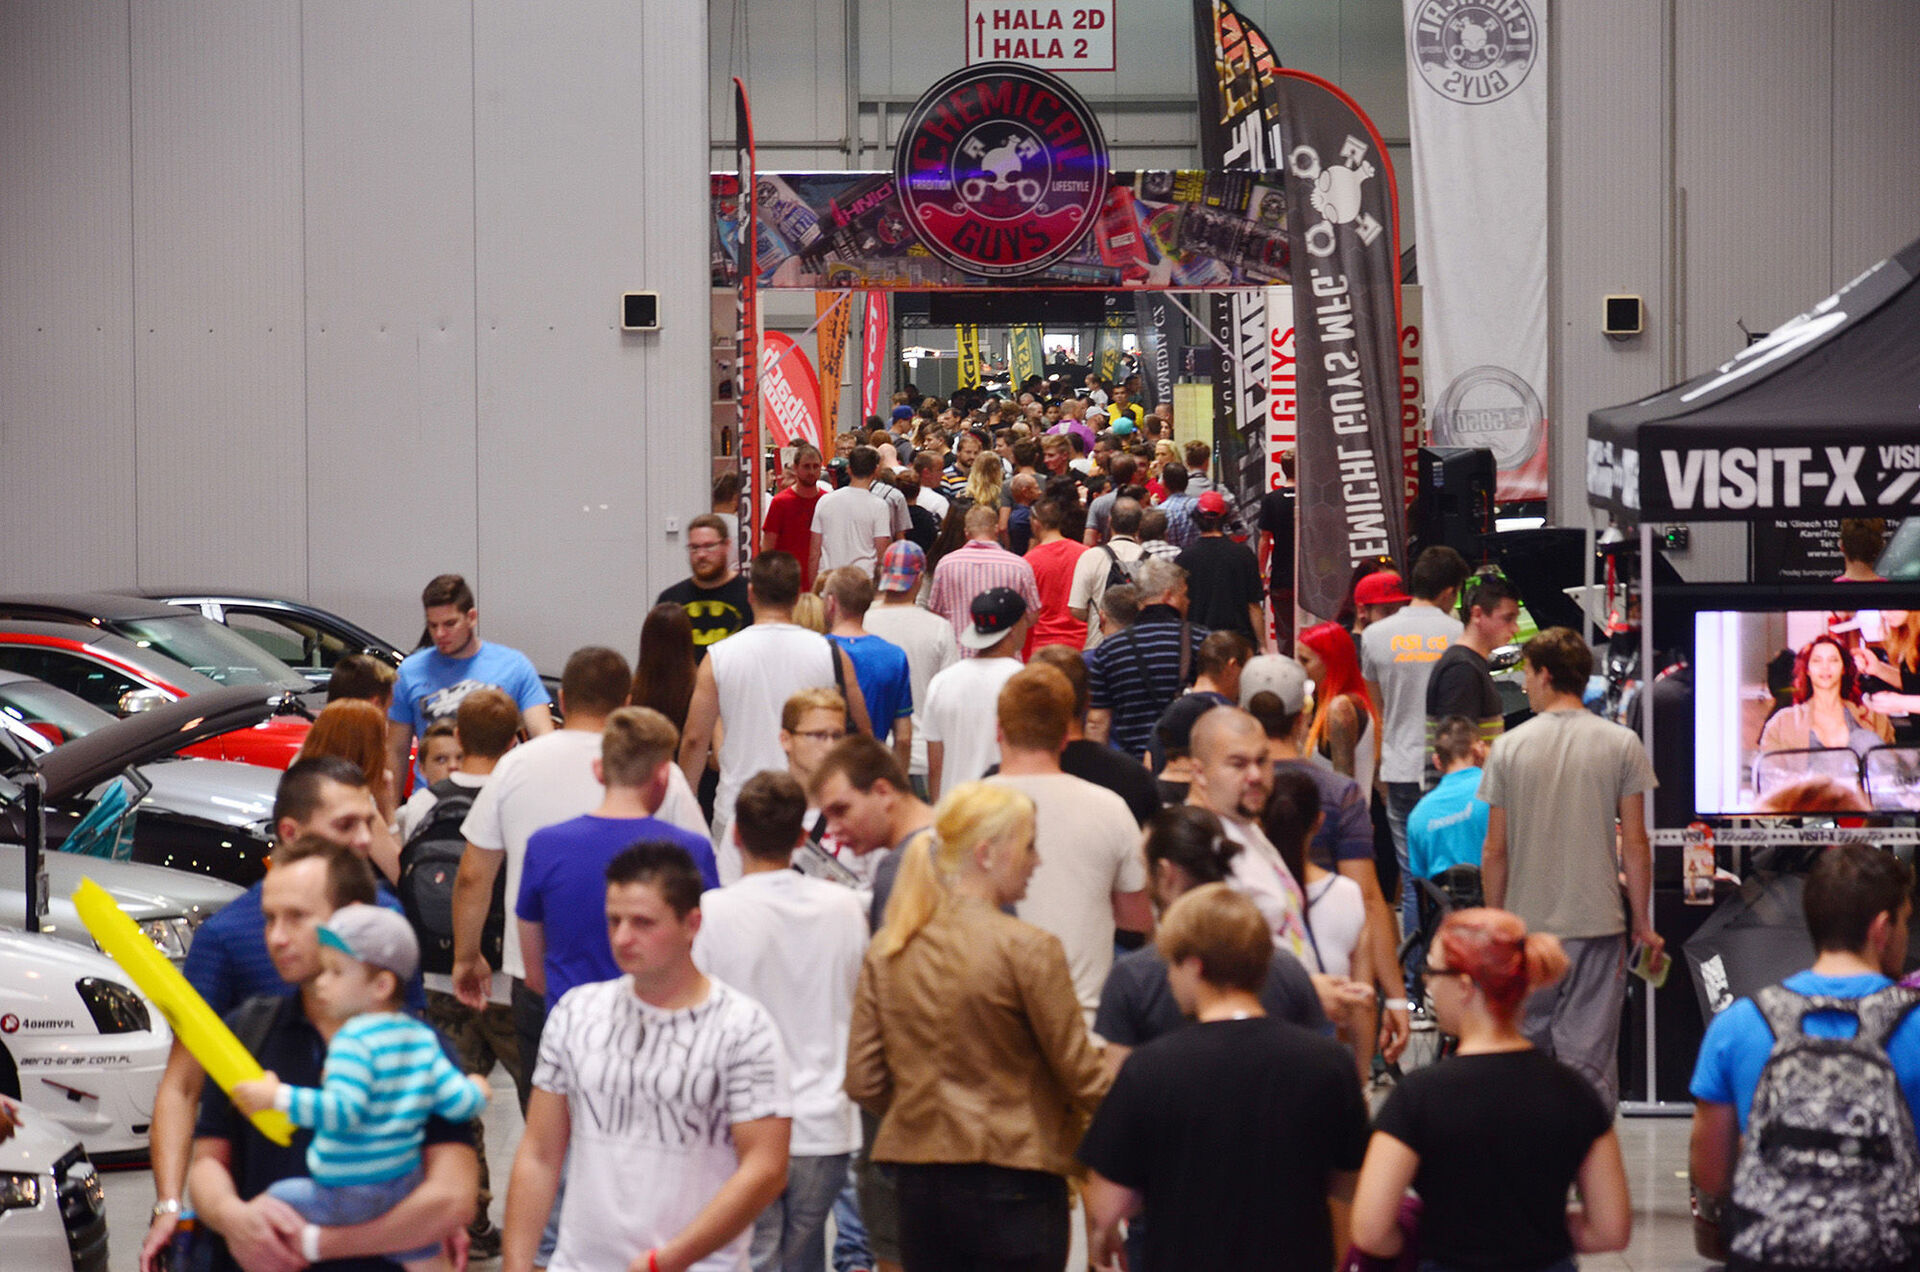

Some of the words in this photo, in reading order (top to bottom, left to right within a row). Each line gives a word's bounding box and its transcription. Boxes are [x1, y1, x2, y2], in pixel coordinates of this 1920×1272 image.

[993, 9, 1064, 30] HALA
[1073, 9, 1106, 30] 2D
[993, 38, 1064, 59] HALA
[1073, 38, 1088, 59] 2
[910, 81, 1091, 172] CHEMICAL
[1051, 180, 1090, 192] LIFESTYLE
[952, 218, 1051, 261] GUYS
[1660, 446, 1867, 509] VISIT-X
